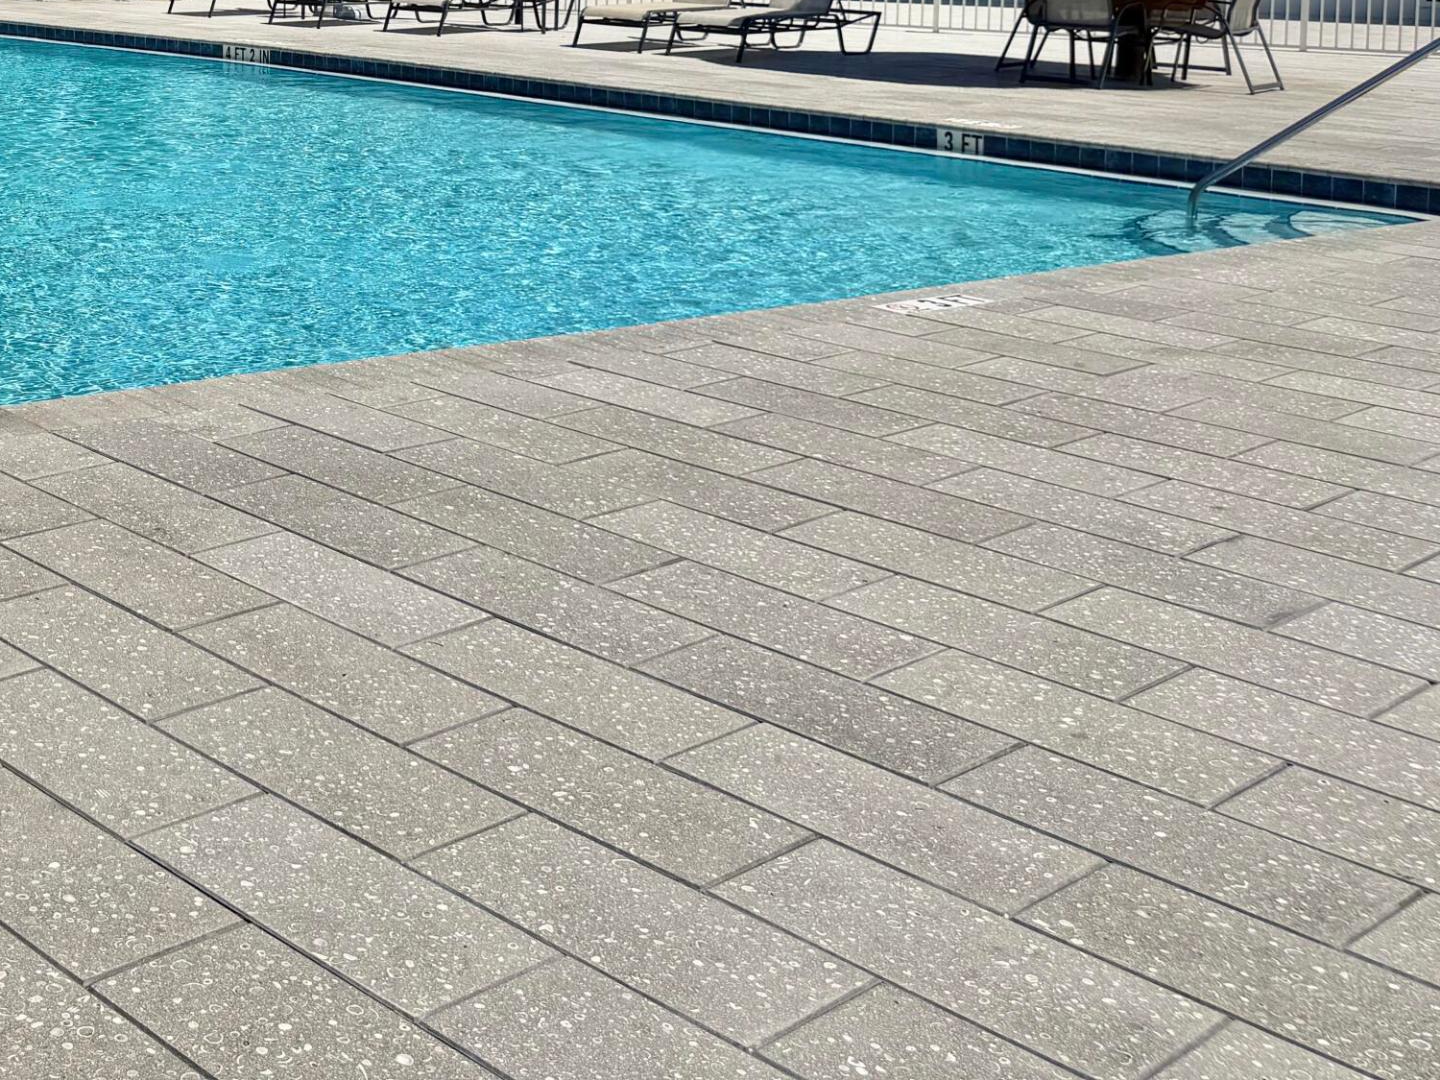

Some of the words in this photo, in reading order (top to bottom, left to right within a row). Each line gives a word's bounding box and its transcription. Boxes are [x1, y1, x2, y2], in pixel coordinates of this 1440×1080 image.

[225, 46, 231, 60] 4
[234, 47, 247, 61] FT
[249, 49, 255, 62] 2
[260, 49, 270, 64] IN
[944, 131, 953, 151] 3
[962, 133, 983, 155] FT
